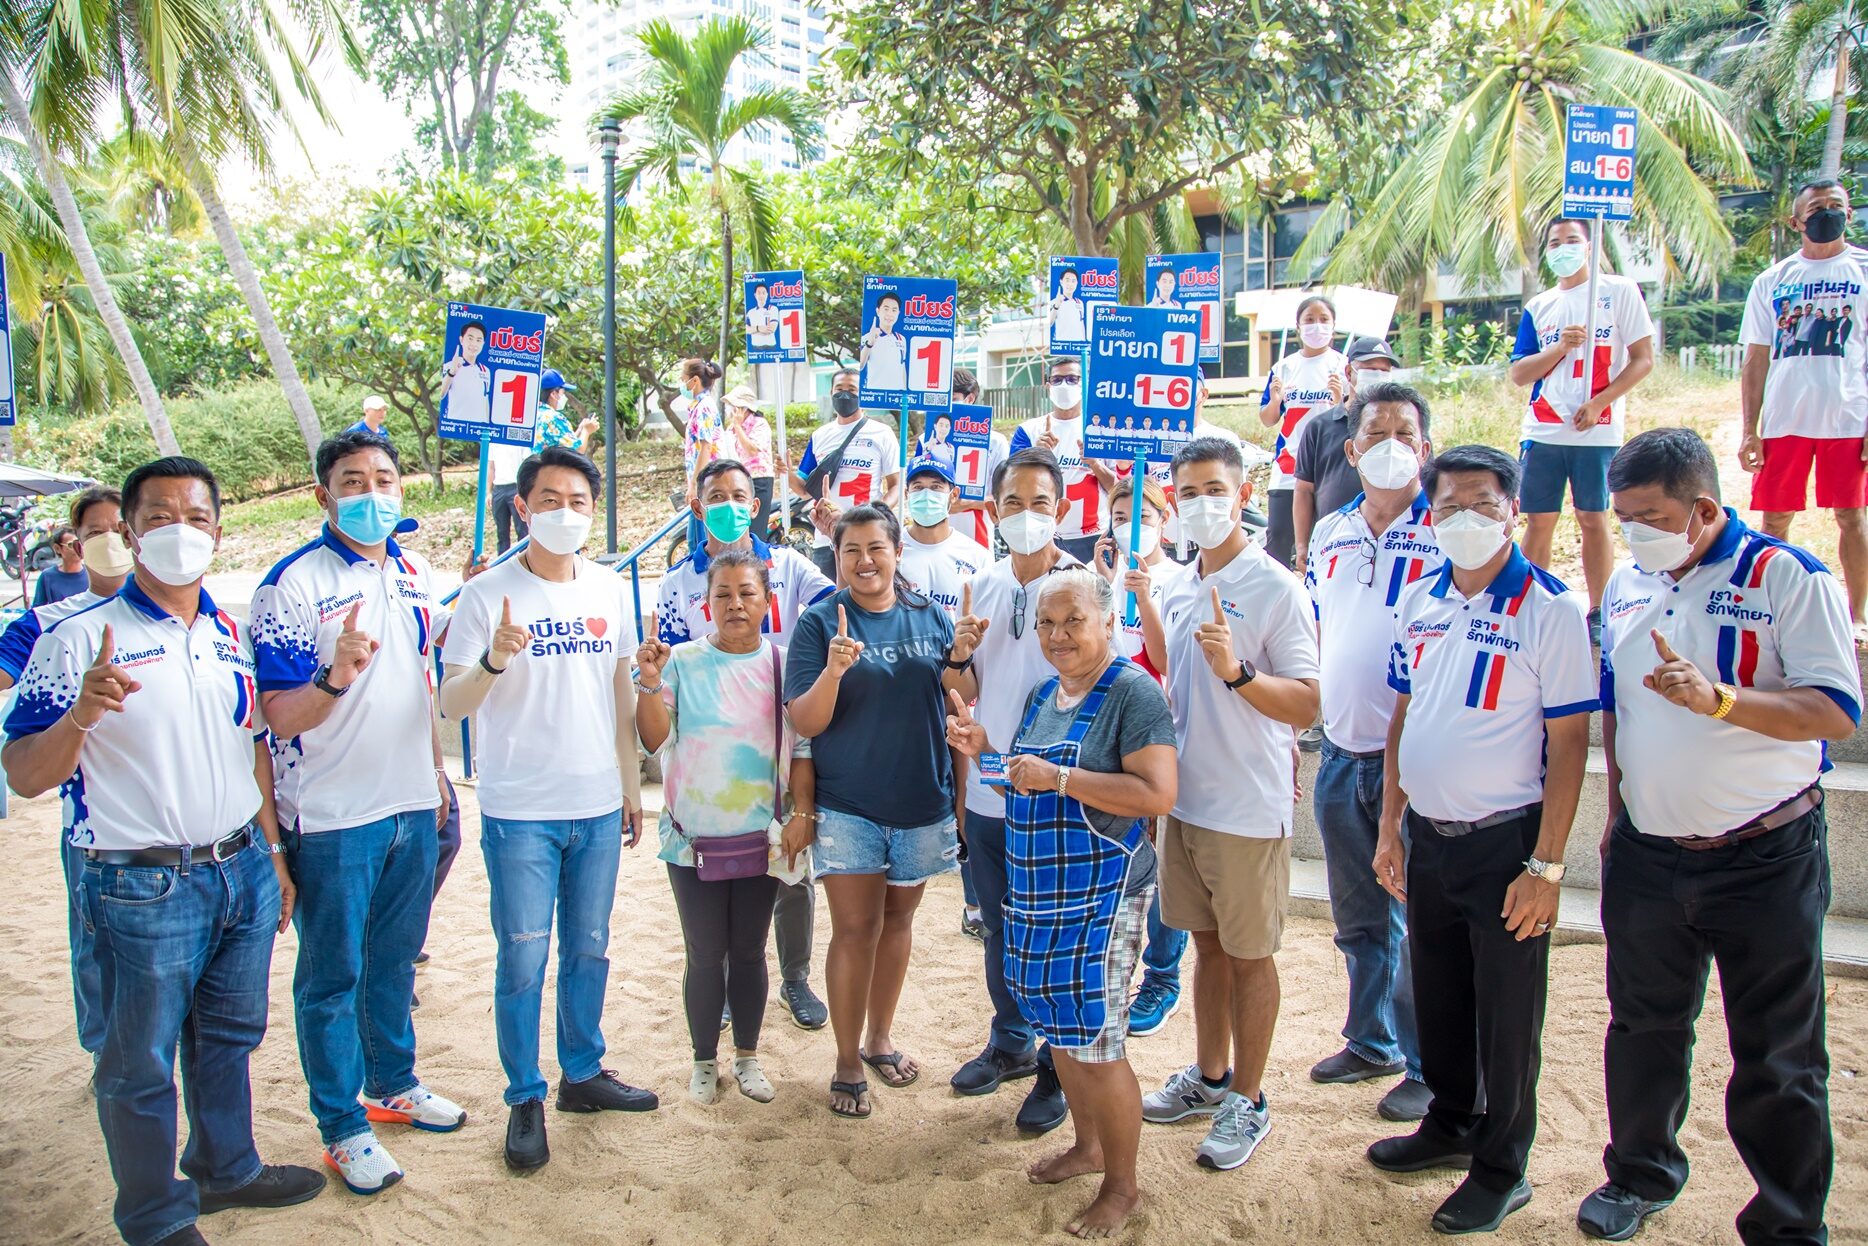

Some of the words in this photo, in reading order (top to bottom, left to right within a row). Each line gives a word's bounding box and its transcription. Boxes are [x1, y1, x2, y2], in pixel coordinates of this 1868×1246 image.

[1572, 130, 1611, 145] นายก
[1618, 126, 1627, 148] 1
[1570, 160, 1595, 175] สม.
[1597, 157, 1630, 180] 1-6
[866, 283, 898, 291] รักพัทยา
[1081, 270, 1117, 287] เบียร์
[1179, 265, 1219, 287] เบียร์
[769, 280, 802, 297] เบียร์
[450, 310, 483, 320] รักพัทยา
[904, 294, 954, 319] เบียร์
[783, 311, 800, 346] 1
[1096, 314, 1132, 323] รักพัทยา
[1167, 313, 1197, 324] เขต4
[489, 326, 542, 353] เบียร์
[1100, 328, 1135, 338] โปรดเลือก
[1099, 339, 1158, 359] นายก
[1170, 334, 1186, 364] 1
[917, 340, 941, 389] 1
[501, 374, 528, 424] 1
[1095, 380, 1133, 400] สม.
[1136, 376, 1190, 408] 1-6
[953, 416, 990, 435] เบียร์
[962, 450, 980, 484] 1
[1066, 473, 1100, 535] 1
[1386, 530, 1407, 540] เรา
[1384, 539, 1440, 556] รักพัทยา
[1326, 554, 1339, 579] 1
[395, 579, 409, 588] เรา
[1708, 590, 1732, 603] เรา
[700, 601, 712, 623] 1
[1705, 600, 1774, 626] รักพัทยา
[528, 616, 585, 638] เบียร์
[1469, 619, 1491, 631] เรา
[212, 640, 231, 652] เรา
[531, 635, 612, 657] รักพัทยา
[1466, 628, 1520, 652] รักพัทยา
[123, 644, 166, 663] ปรเมศวร์
[1412, 642, 1425, 669] 1
